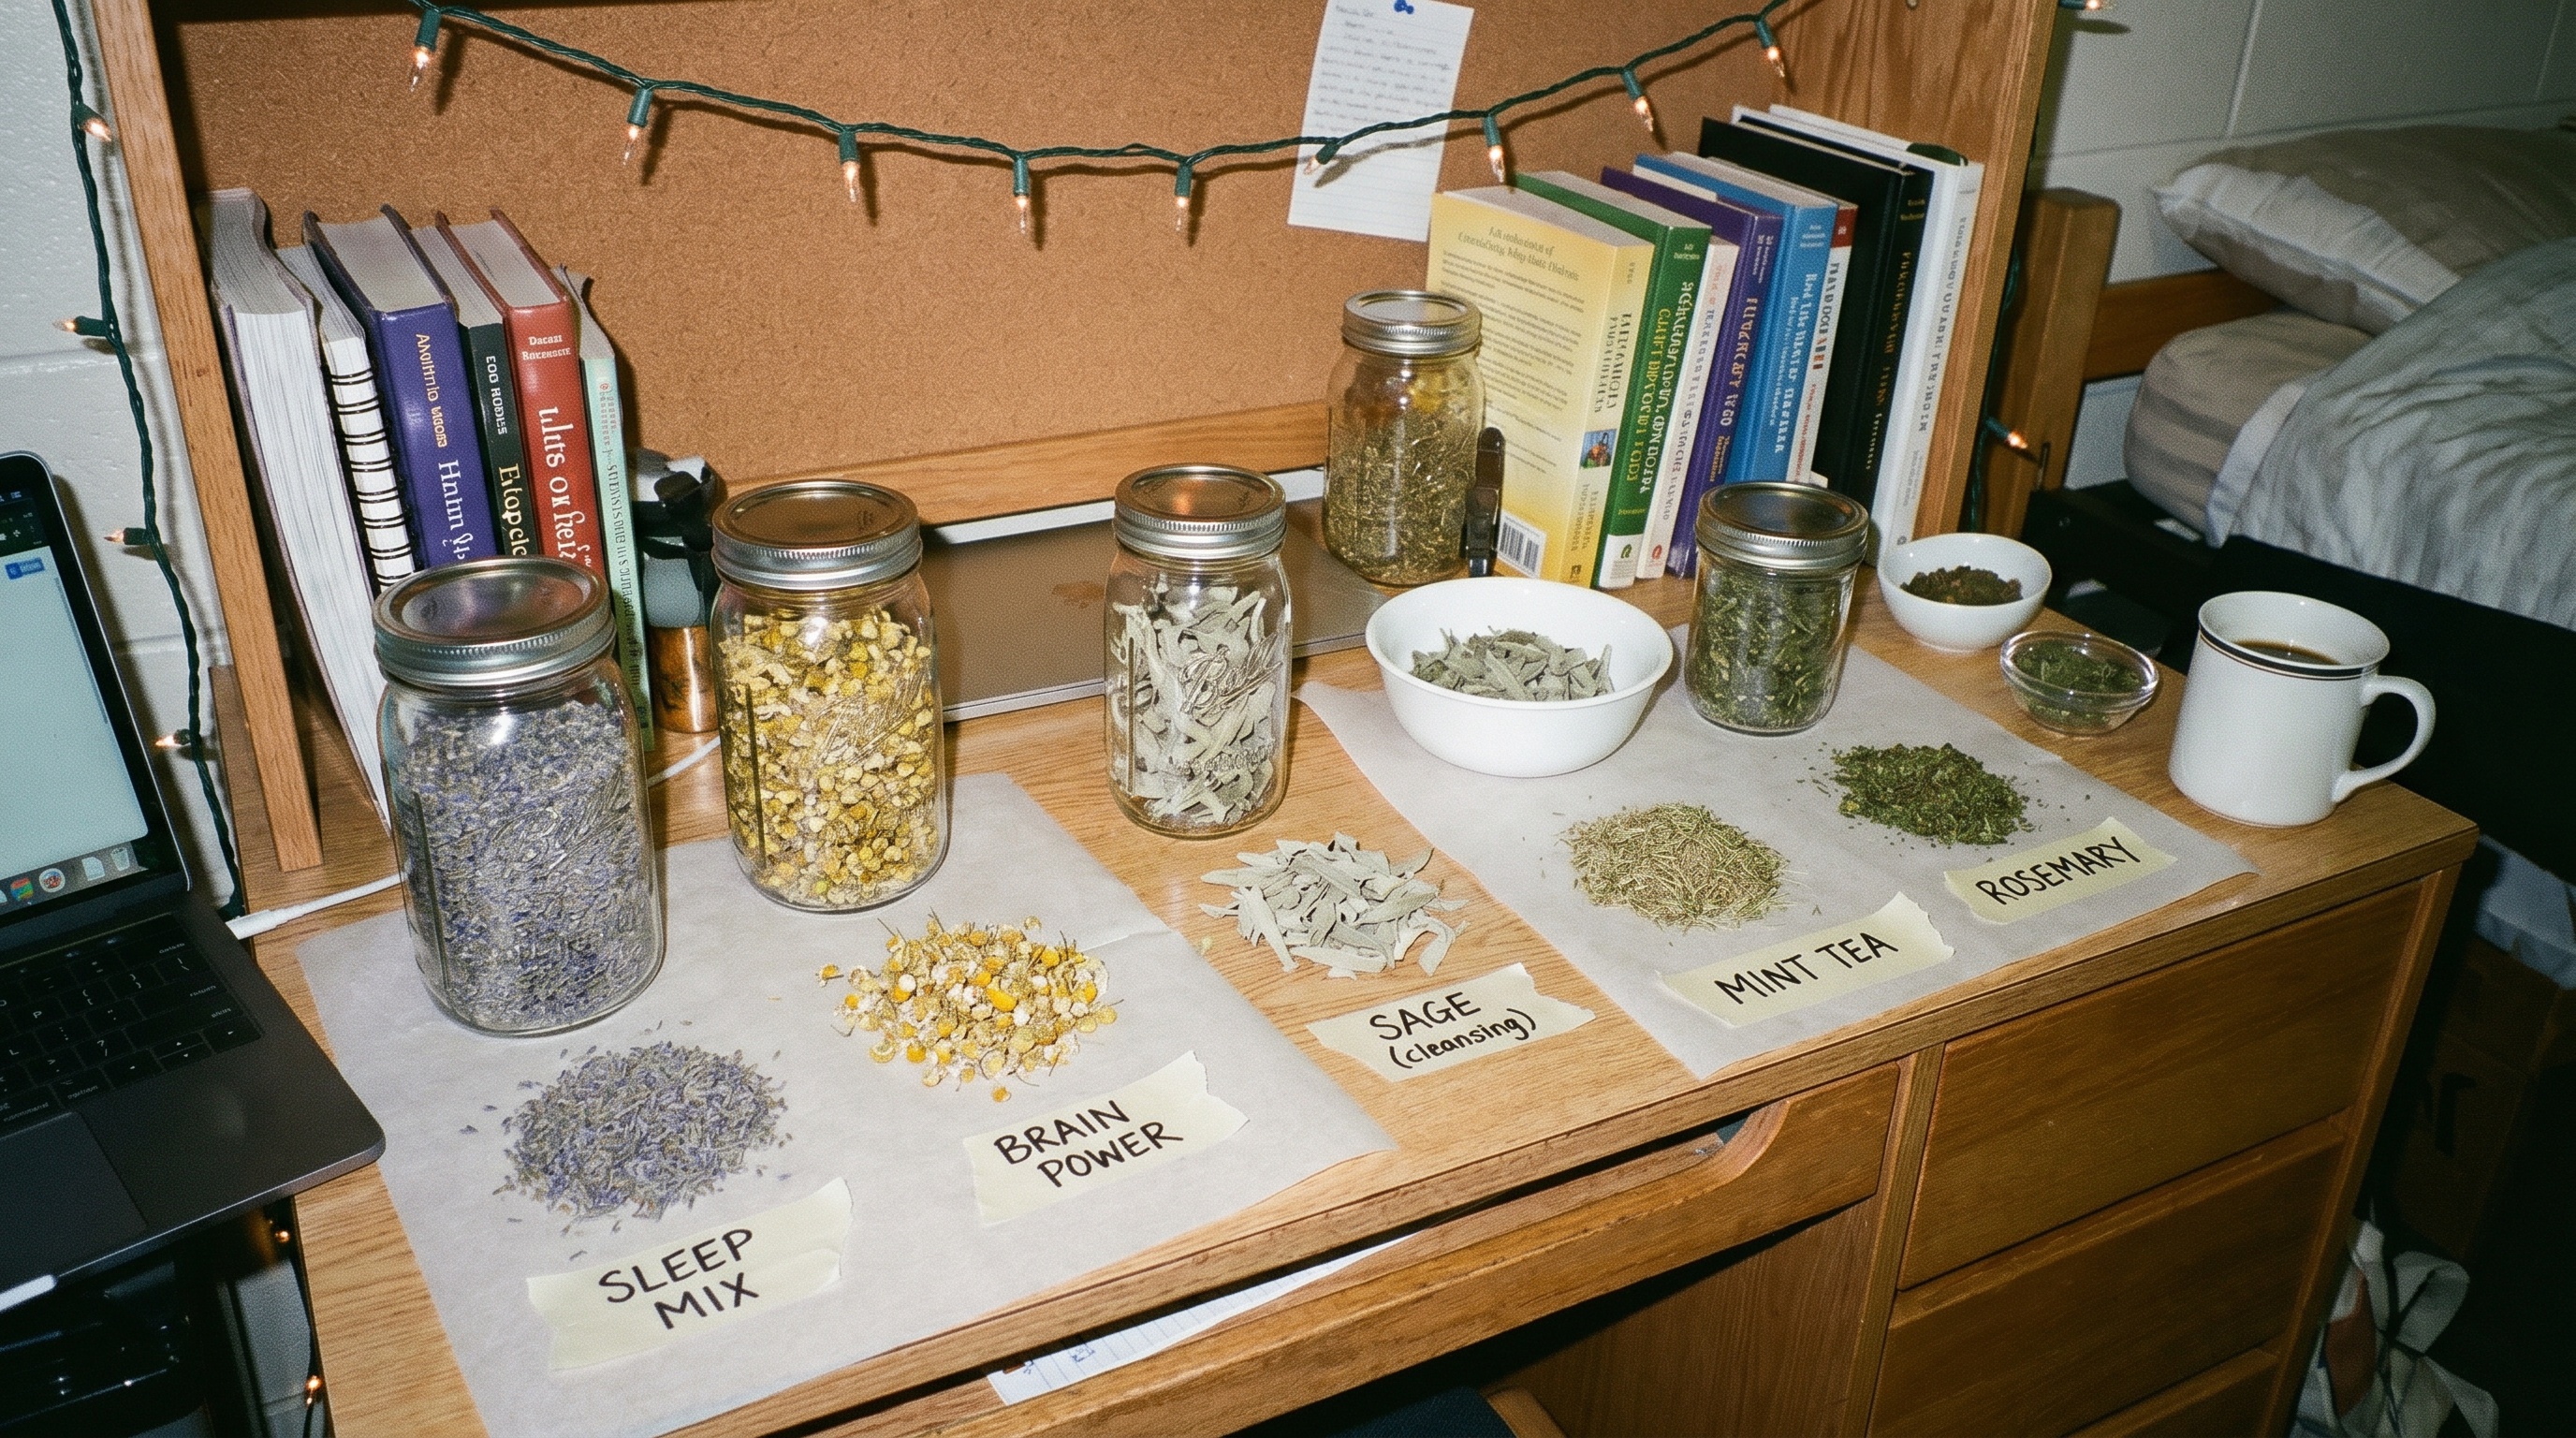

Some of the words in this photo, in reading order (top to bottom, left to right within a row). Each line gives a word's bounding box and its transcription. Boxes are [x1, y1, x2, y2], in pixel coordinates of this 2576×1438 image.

[1975, 836, 2142, 905] ROSEMARY
[1714, 954, 1818, 1005] MINT
[1814, 932, 1898, 969] TEA
[1369, 991, 1481, 1040] SAGE
[1389, 1008, 1537, 1069] (cleansing)
[994, 1100, 1130, 1165] BRAIN
[1037, 1122, 1183, 1187] POWER
[598, 1228, 754, 1303] SLEEP
[654, 1272, 759, 1329] MIX
